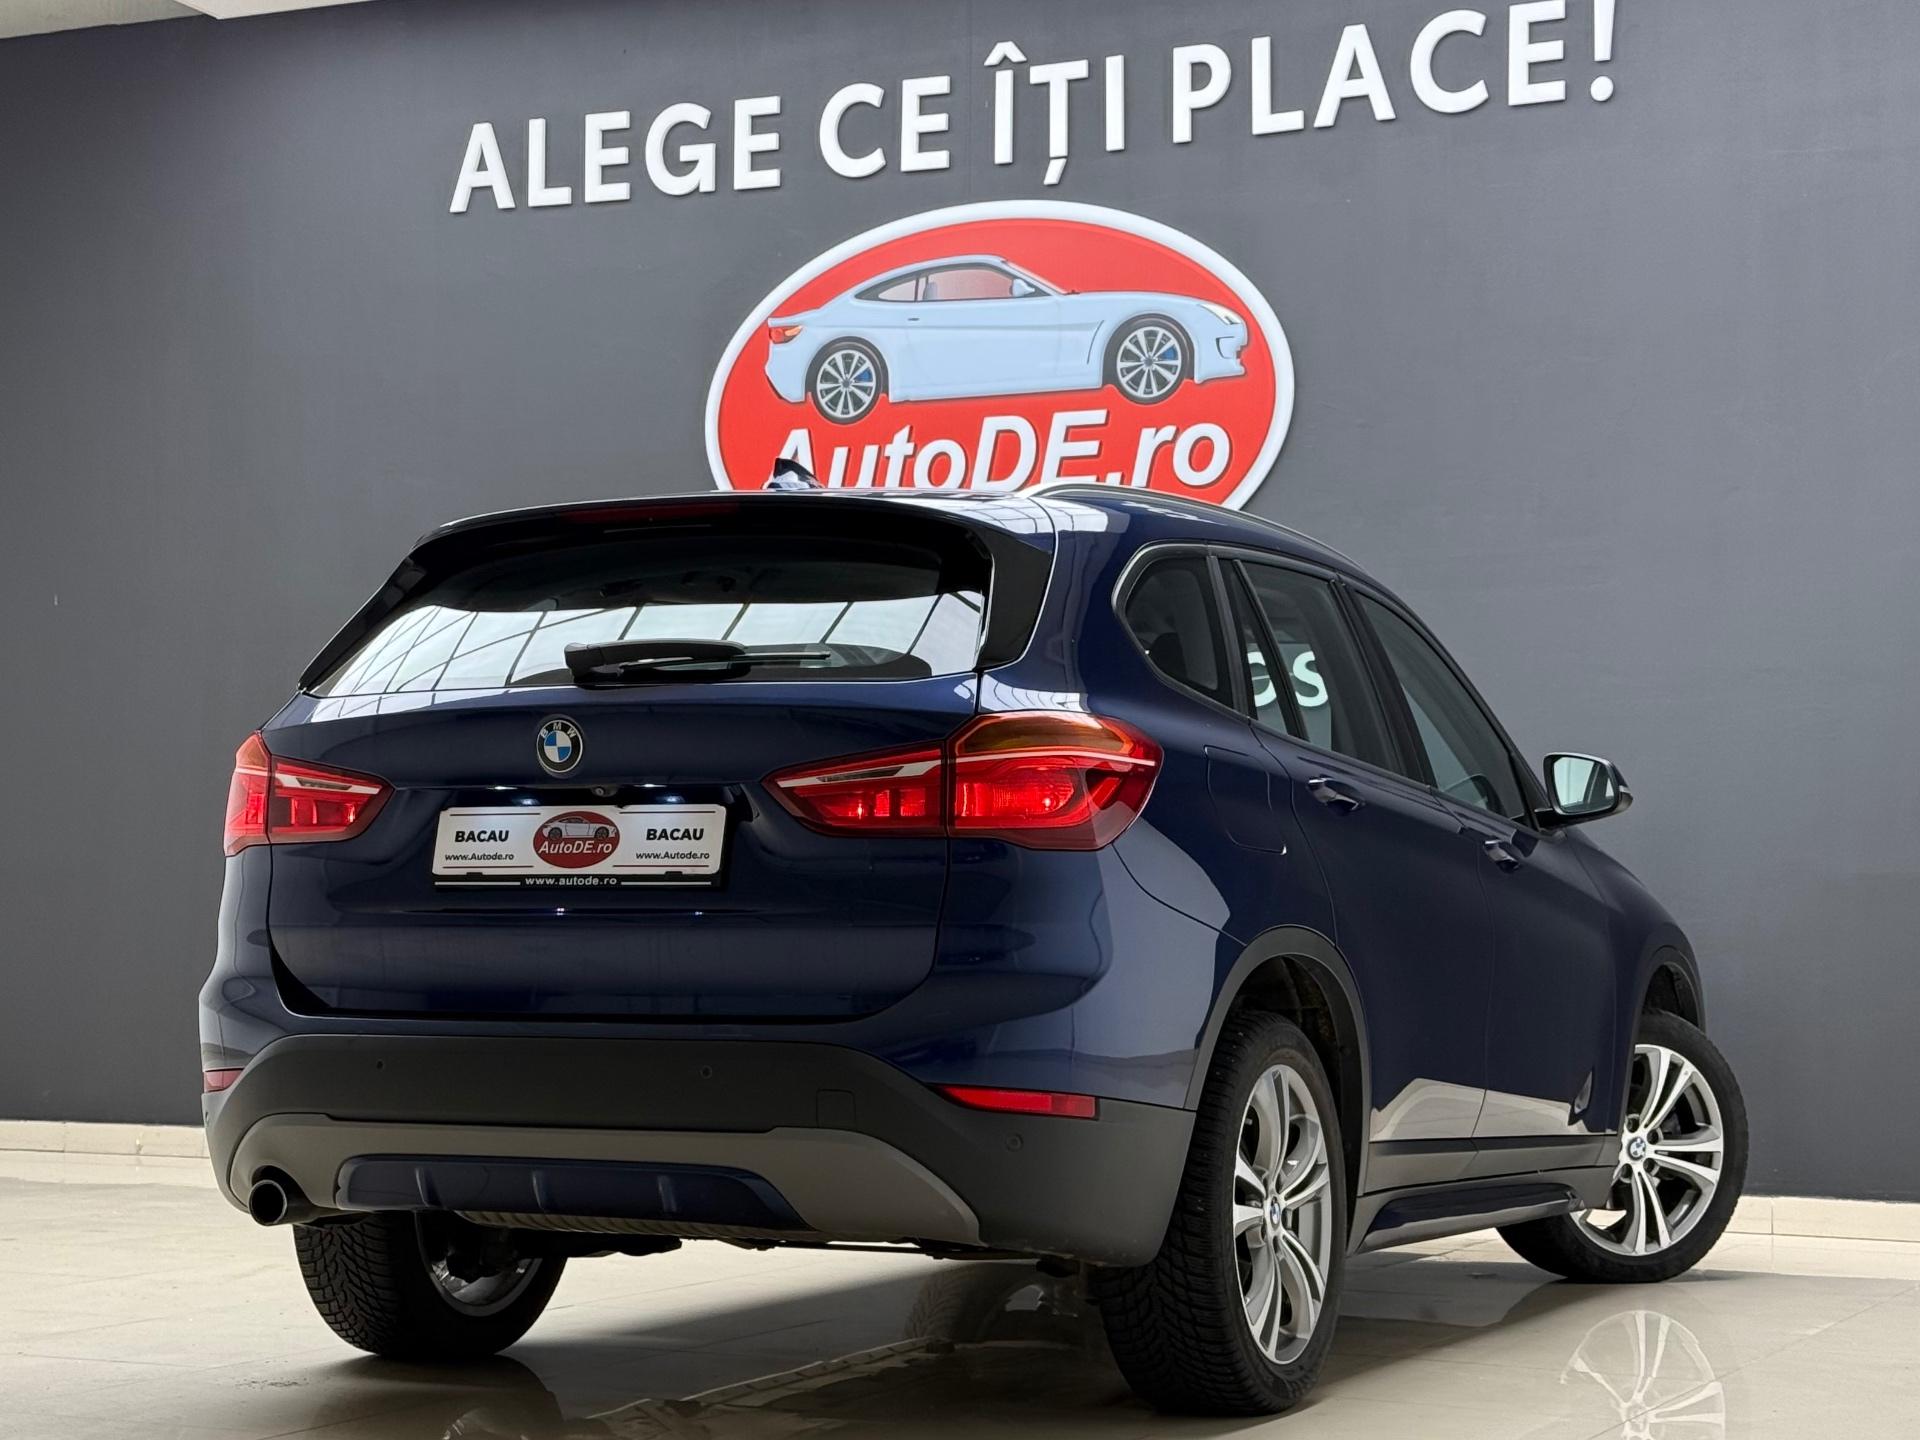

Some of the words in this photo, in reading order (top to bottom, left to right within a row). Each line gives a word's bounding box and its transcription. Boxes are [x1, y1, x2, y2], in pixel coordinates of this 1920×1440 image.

[450, 96, 781, 213] ALEGE
[819, 75, 951, 178] CE
[1172, 0, 1616, 144] PLACE!
[540, 722, 577, 739] BMW
[454, 829, 510, 843] BACAU
[645, 827, 705, 841] BACAU
[538, 839, 613, 855] AutoDE.ro
[444, 852, 515, 862] www.Autode.ro
[635, 850, 710, 860] www.Autode.ro
[525, 876, 618, 886] www.autode.ro
